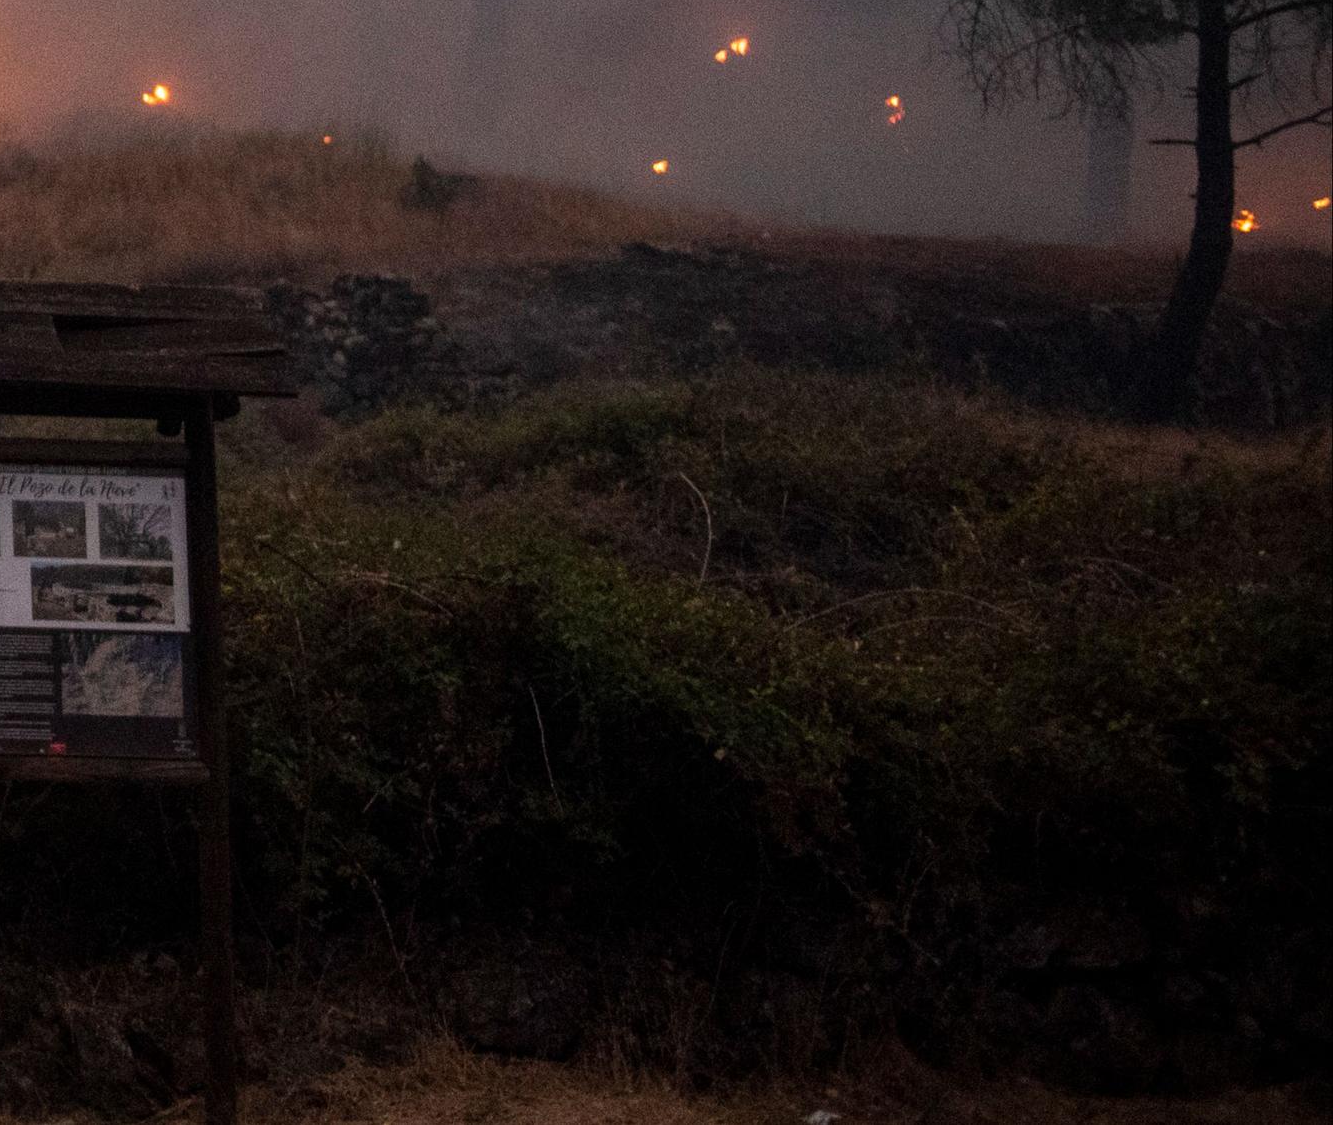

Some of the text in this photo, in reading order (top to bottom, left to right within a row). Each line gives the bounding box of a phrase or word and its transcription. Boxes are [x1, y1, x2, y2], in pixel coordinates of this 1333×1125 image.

[20, 477, 53, 497] Pozo
[58, 480, 75, 495] de
[80, 478, 95, 496] la
